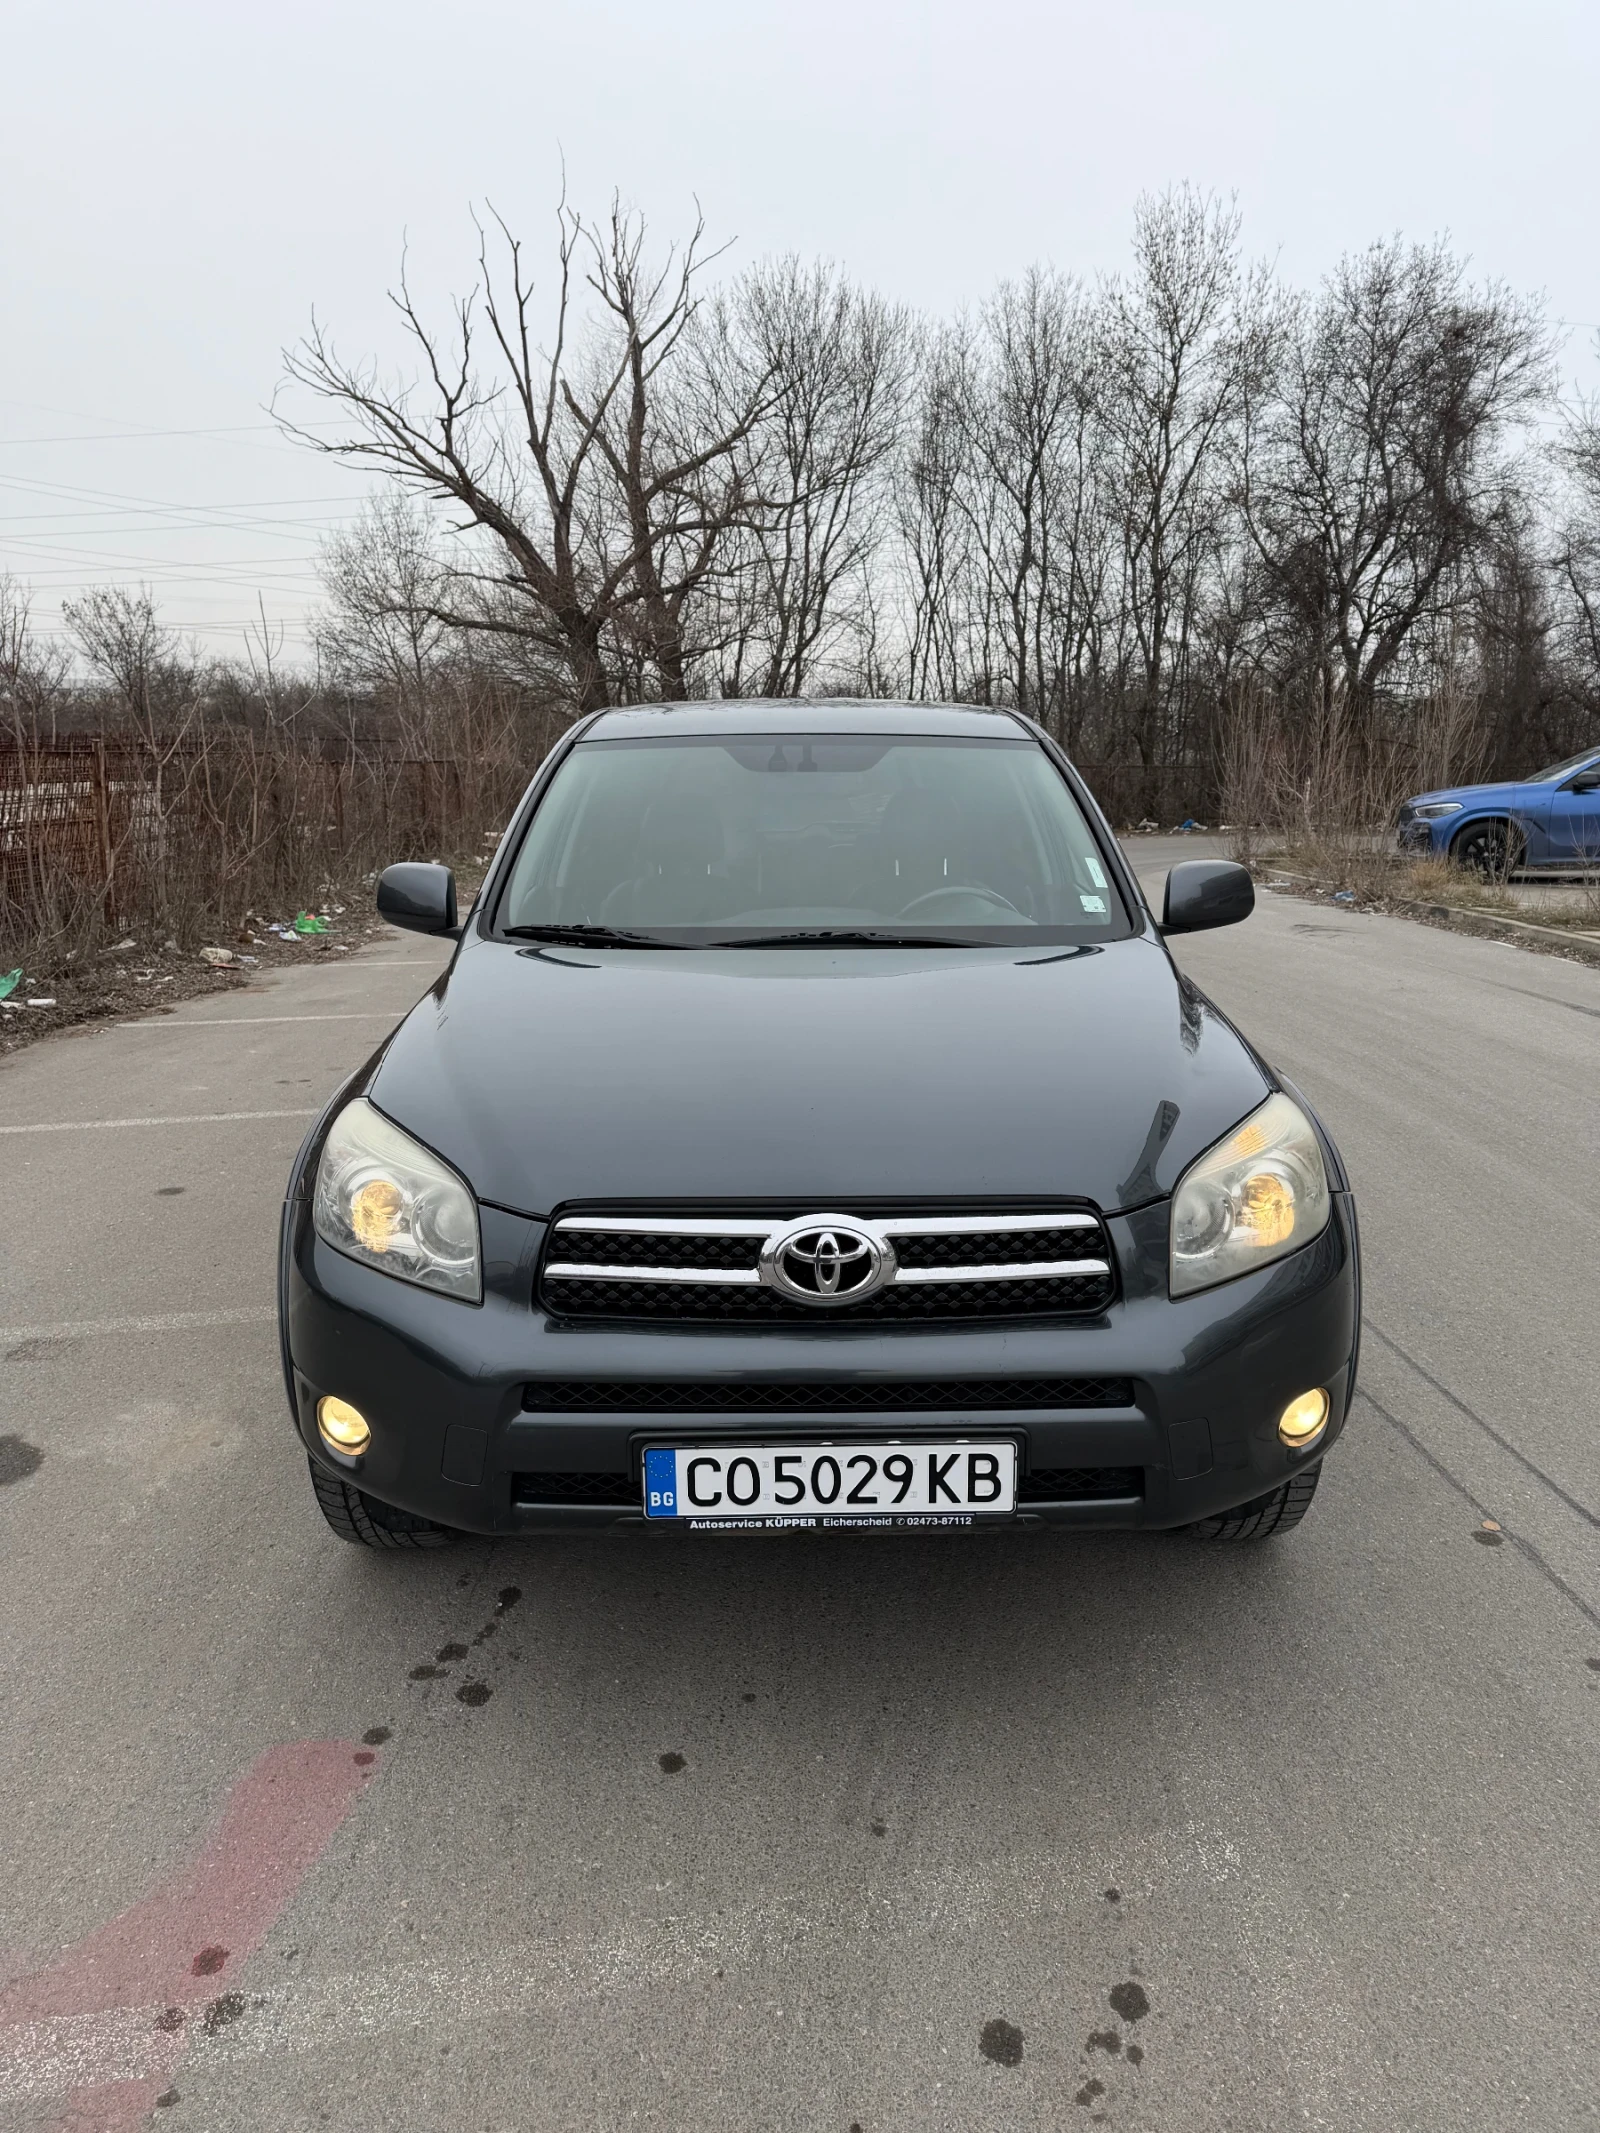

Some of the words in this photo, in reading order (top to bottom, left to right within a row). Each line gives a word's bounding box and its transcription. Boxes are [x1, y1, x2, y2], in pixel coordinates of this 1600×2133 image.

[773, 1454, 914, 1505] 5029
[650, 1491, 674, 1507] BG
[689, 1519, 763, 1530] Autoservice
[765, 1516, 817, 1528] KÜPPER
[822, 1517, 892, 1527] Eicherscheid
[906, 1516, 972, 1526] 02473-87112
